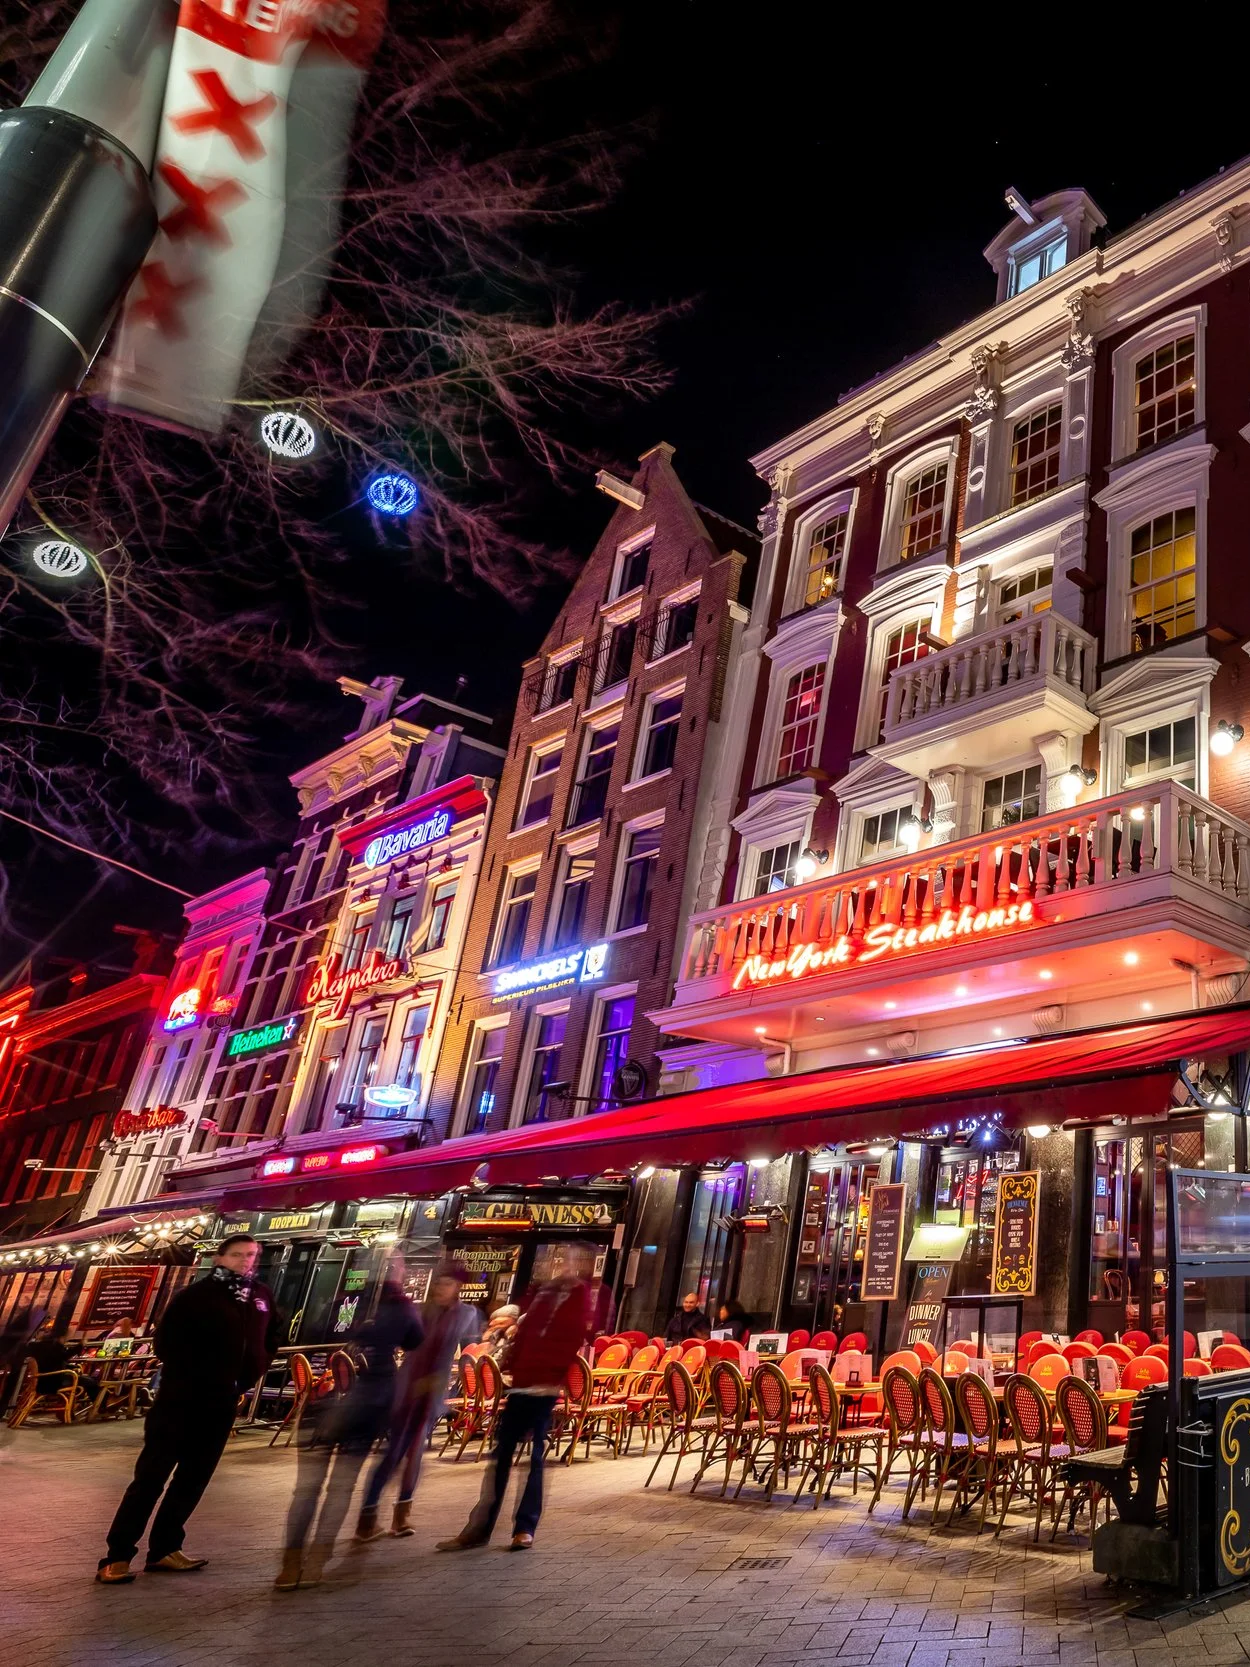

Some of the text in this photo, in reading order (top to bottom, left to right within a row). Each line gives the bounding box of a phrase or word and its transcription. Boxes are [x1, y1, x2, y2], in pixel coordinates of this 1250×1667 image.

[377, 811, 449, 865] Bavaria
[858, 902, 1034, 962] Steakhouse
[307, 950, 398, 1020] Reynders
[229, 1025, 283, 1056] Heineken
[423, 1206, 437, 1220] 4
[268, 1214, 310, 1230] HOOPMAN
[453, 1249, 506, 1260] Hoopman
[480, 1260, 501, 1272] Pub
[919, 1266, 949, 1278] OPEN
[909, 1305, 941, 1320] DINNER
[908, 1328, 932, 1345] LUNCH
